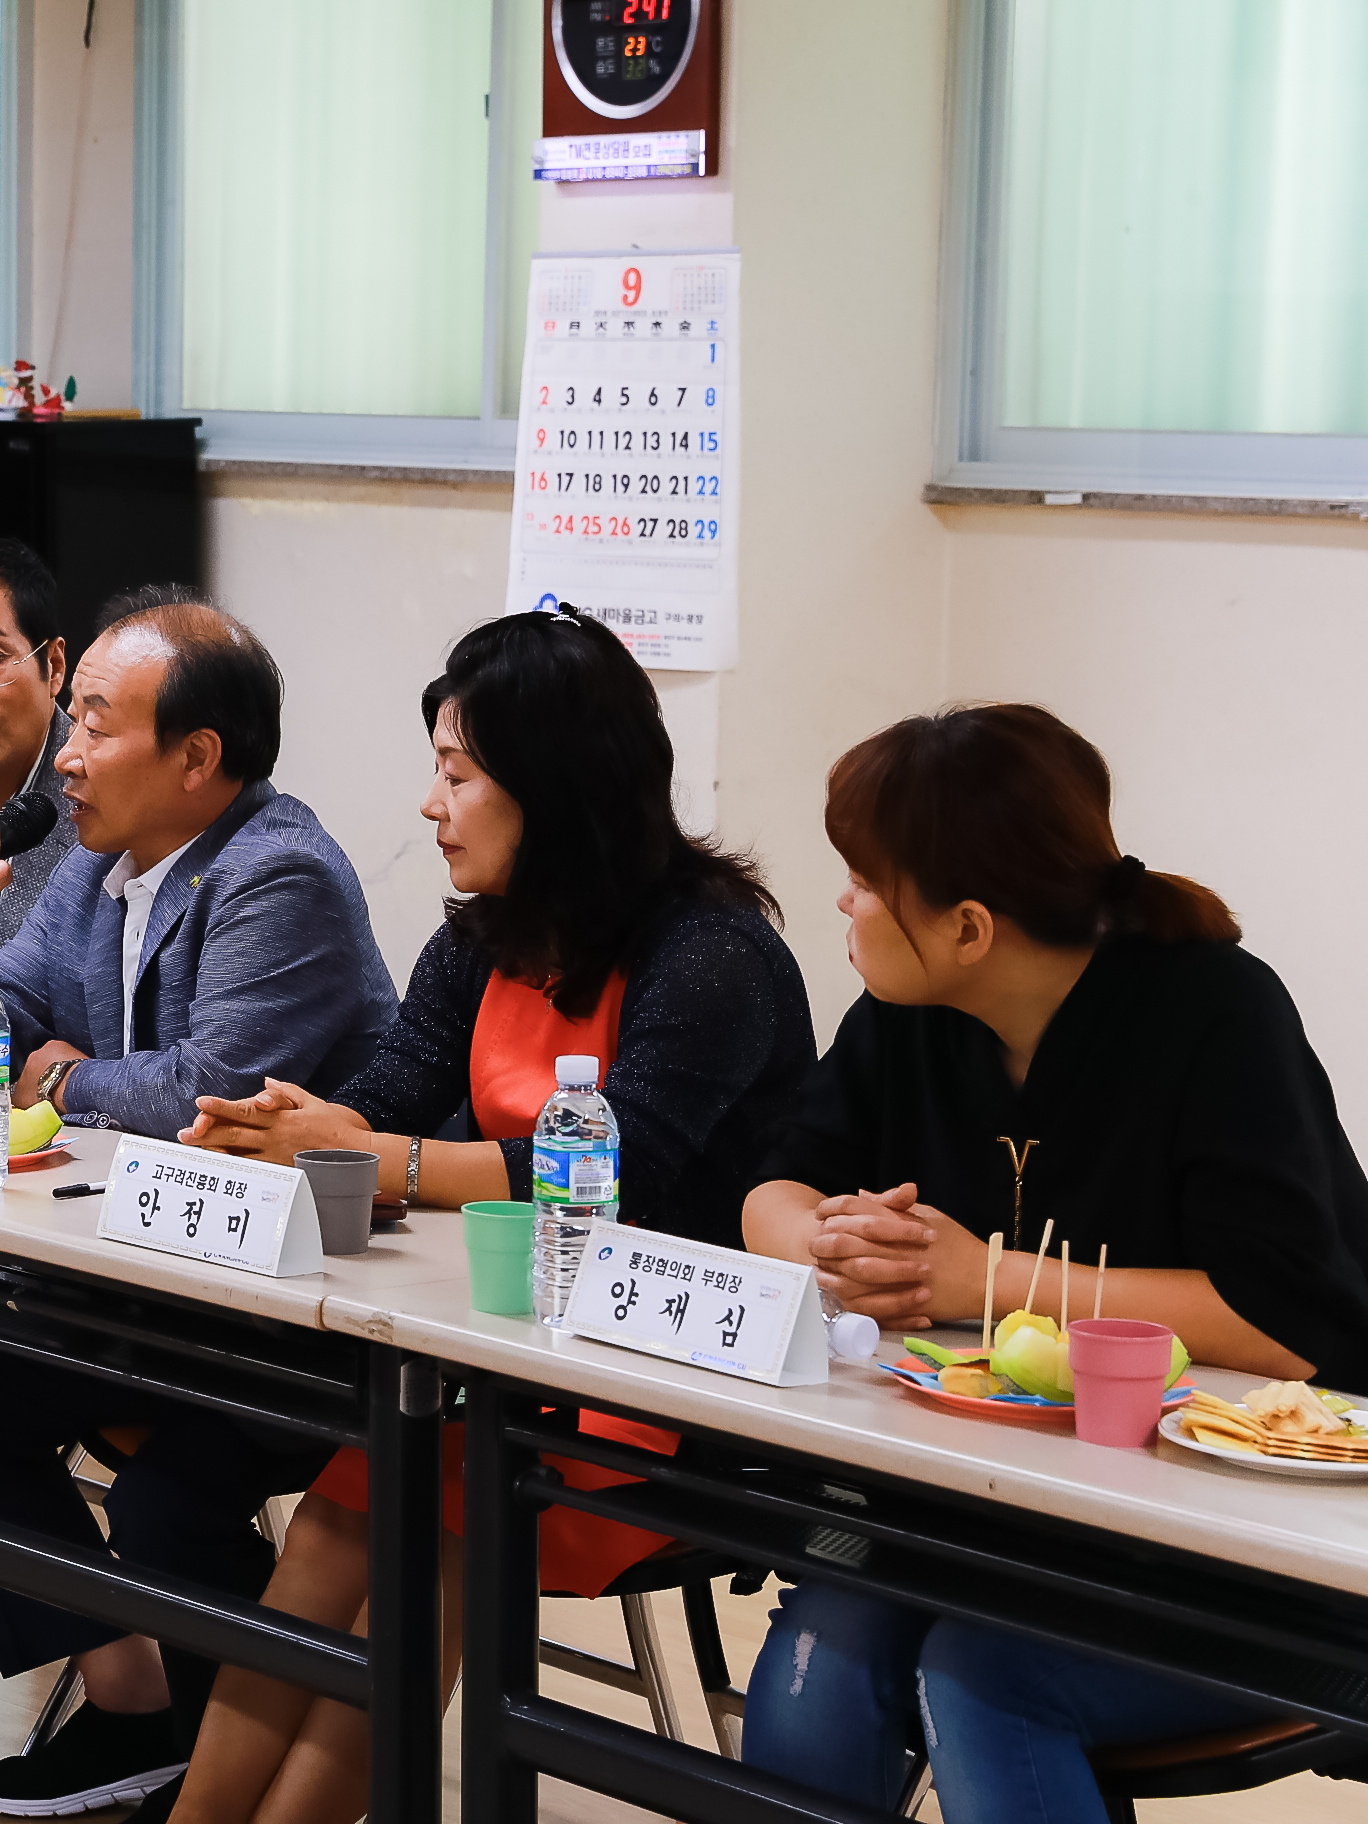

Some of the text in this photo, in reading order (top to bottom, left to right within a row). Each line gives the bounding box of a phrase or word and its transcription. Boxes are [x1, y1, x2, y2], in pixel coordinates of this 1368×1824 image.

[624, 35, 646, 57] 23
[623, 268, 641, 306] 9
[710, 343, 715, 363] 1
[541, 386, 715, 407] 2 3 4 5 6 7 8
[537, 429, 718, 452] 9 10 11 12 13 14 15
[531, 472, 719, 496] 16 17 18 19 20 21 22
[554, 515, 573, 534] 24
[581, 516, 601, 535] 25
[609, 517, 630, 536] 26
[637, 518, 658, 537] 27
[667, 519, 688, 538] 28
[695, 520, 717, 539] 29
[152, 1163, 220, 1193] 고구려진흥회
[222, 1179, 248, 1199] 회장
[628, 1251, 696, 1283] 통장협의회
[701, 1268, 743, 1294] 부회장
